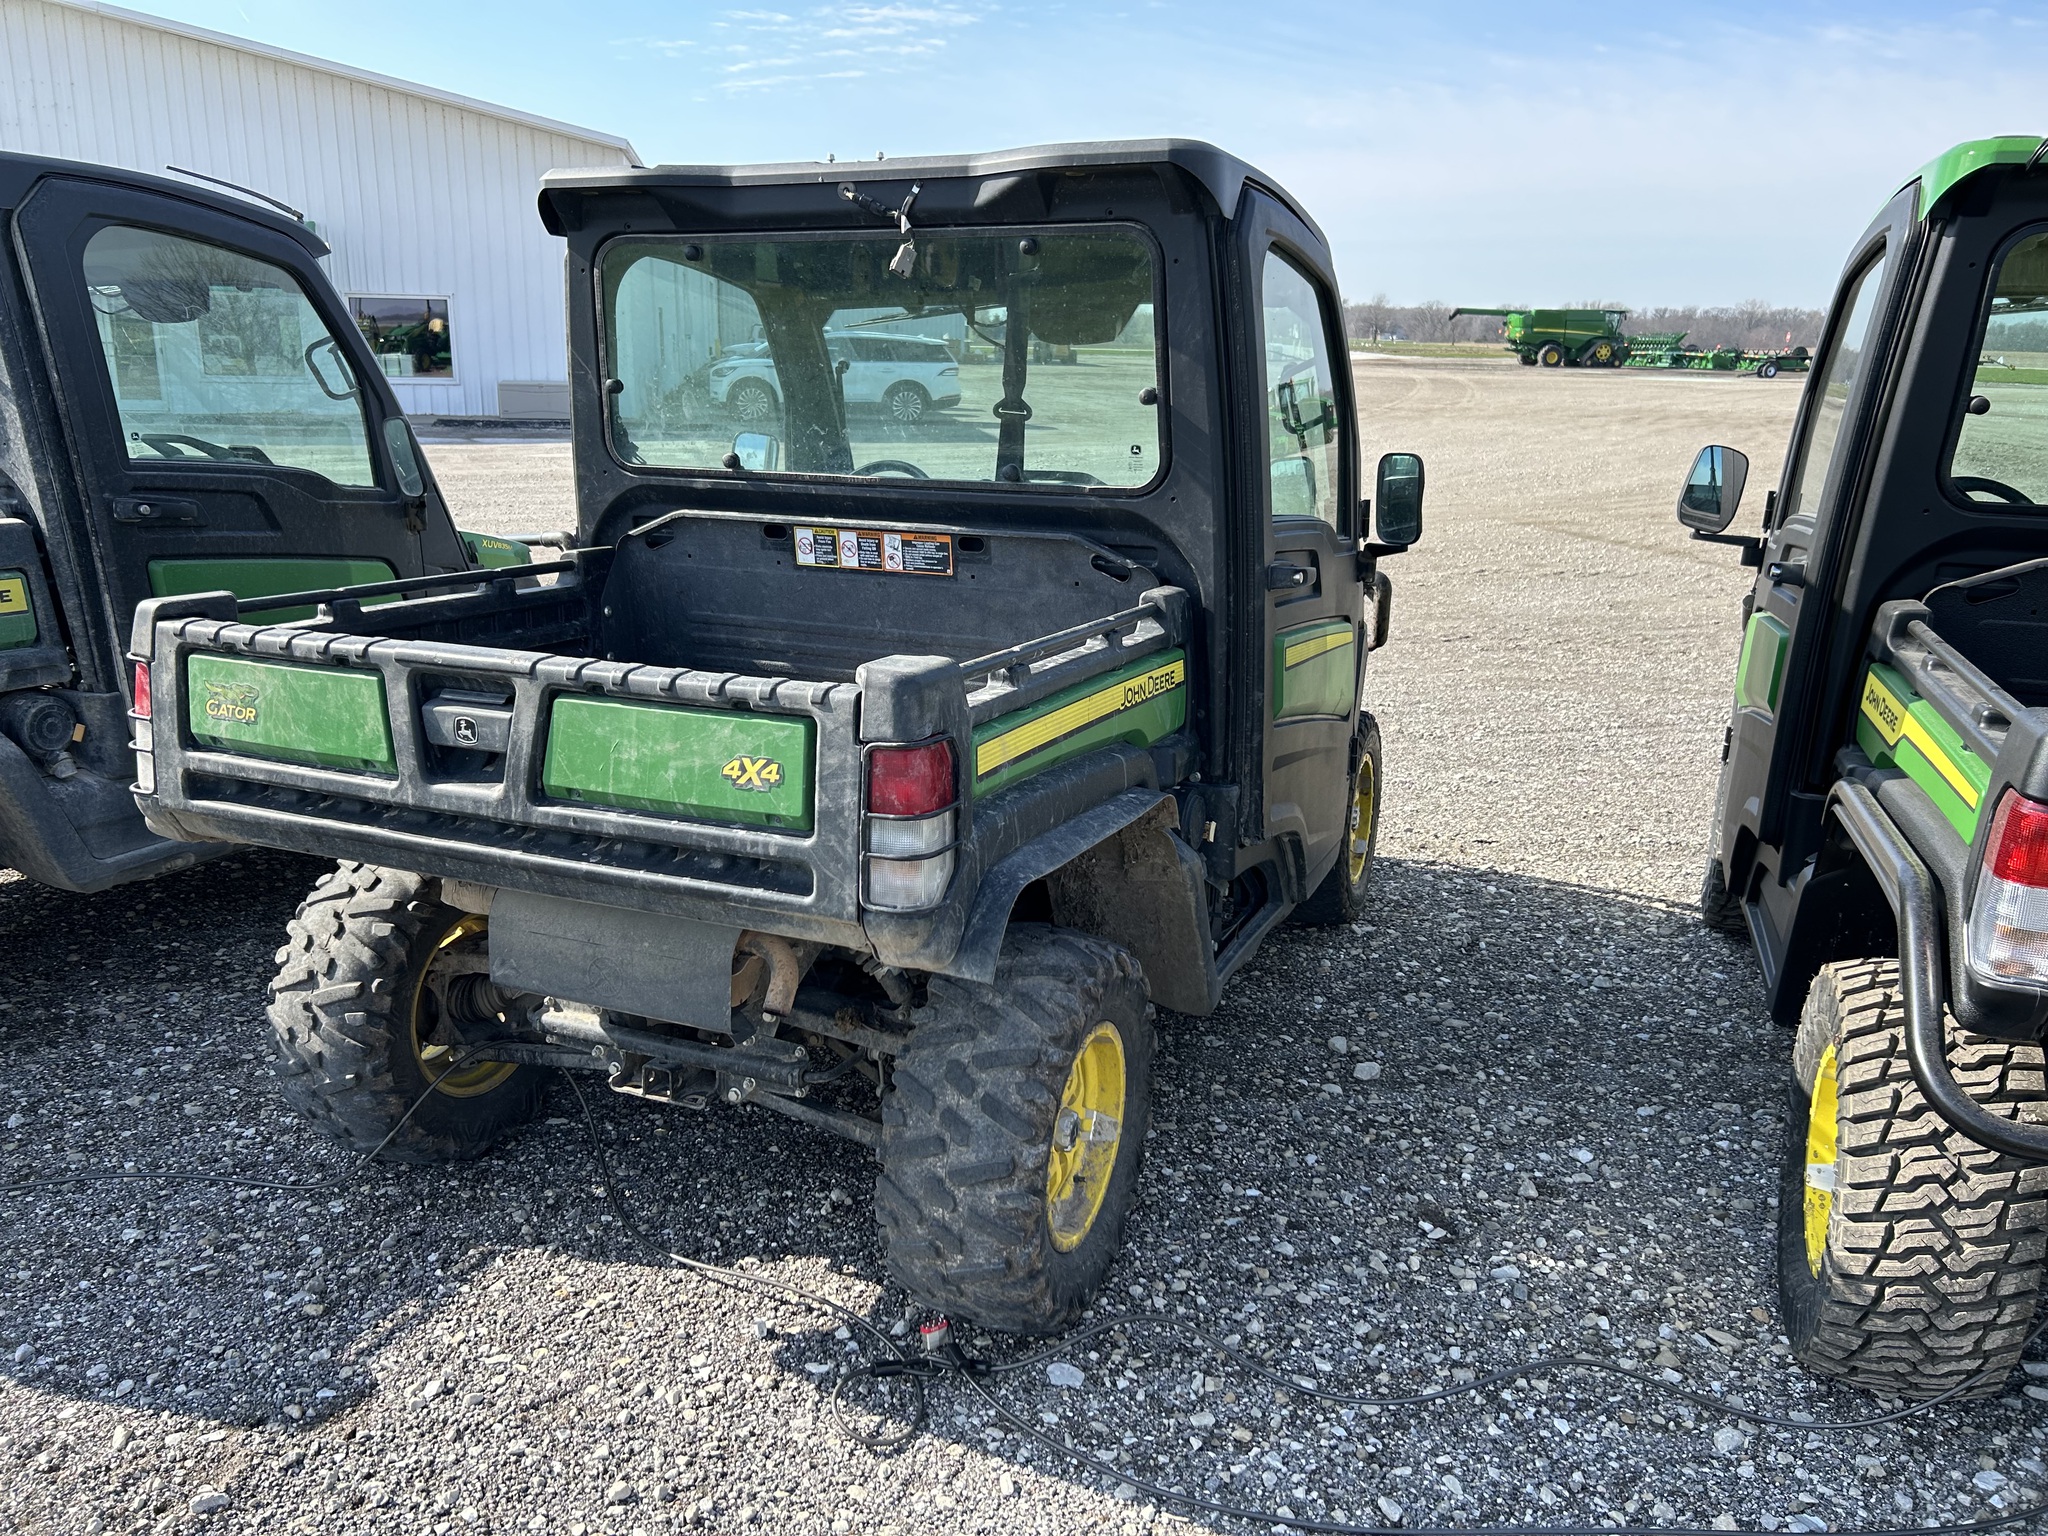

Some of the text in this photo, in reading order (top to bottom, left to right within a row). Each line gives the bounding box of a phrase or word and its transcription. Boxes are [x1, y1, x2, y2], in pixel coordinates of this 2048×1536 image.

[1120, 670, 1176, 708] JOHN DEERE
[205, 699, 257, 722] GATOR
[1865, 683, 1899, 733] JOHN DEERE
[722, 757, 780, 787] 4X4
